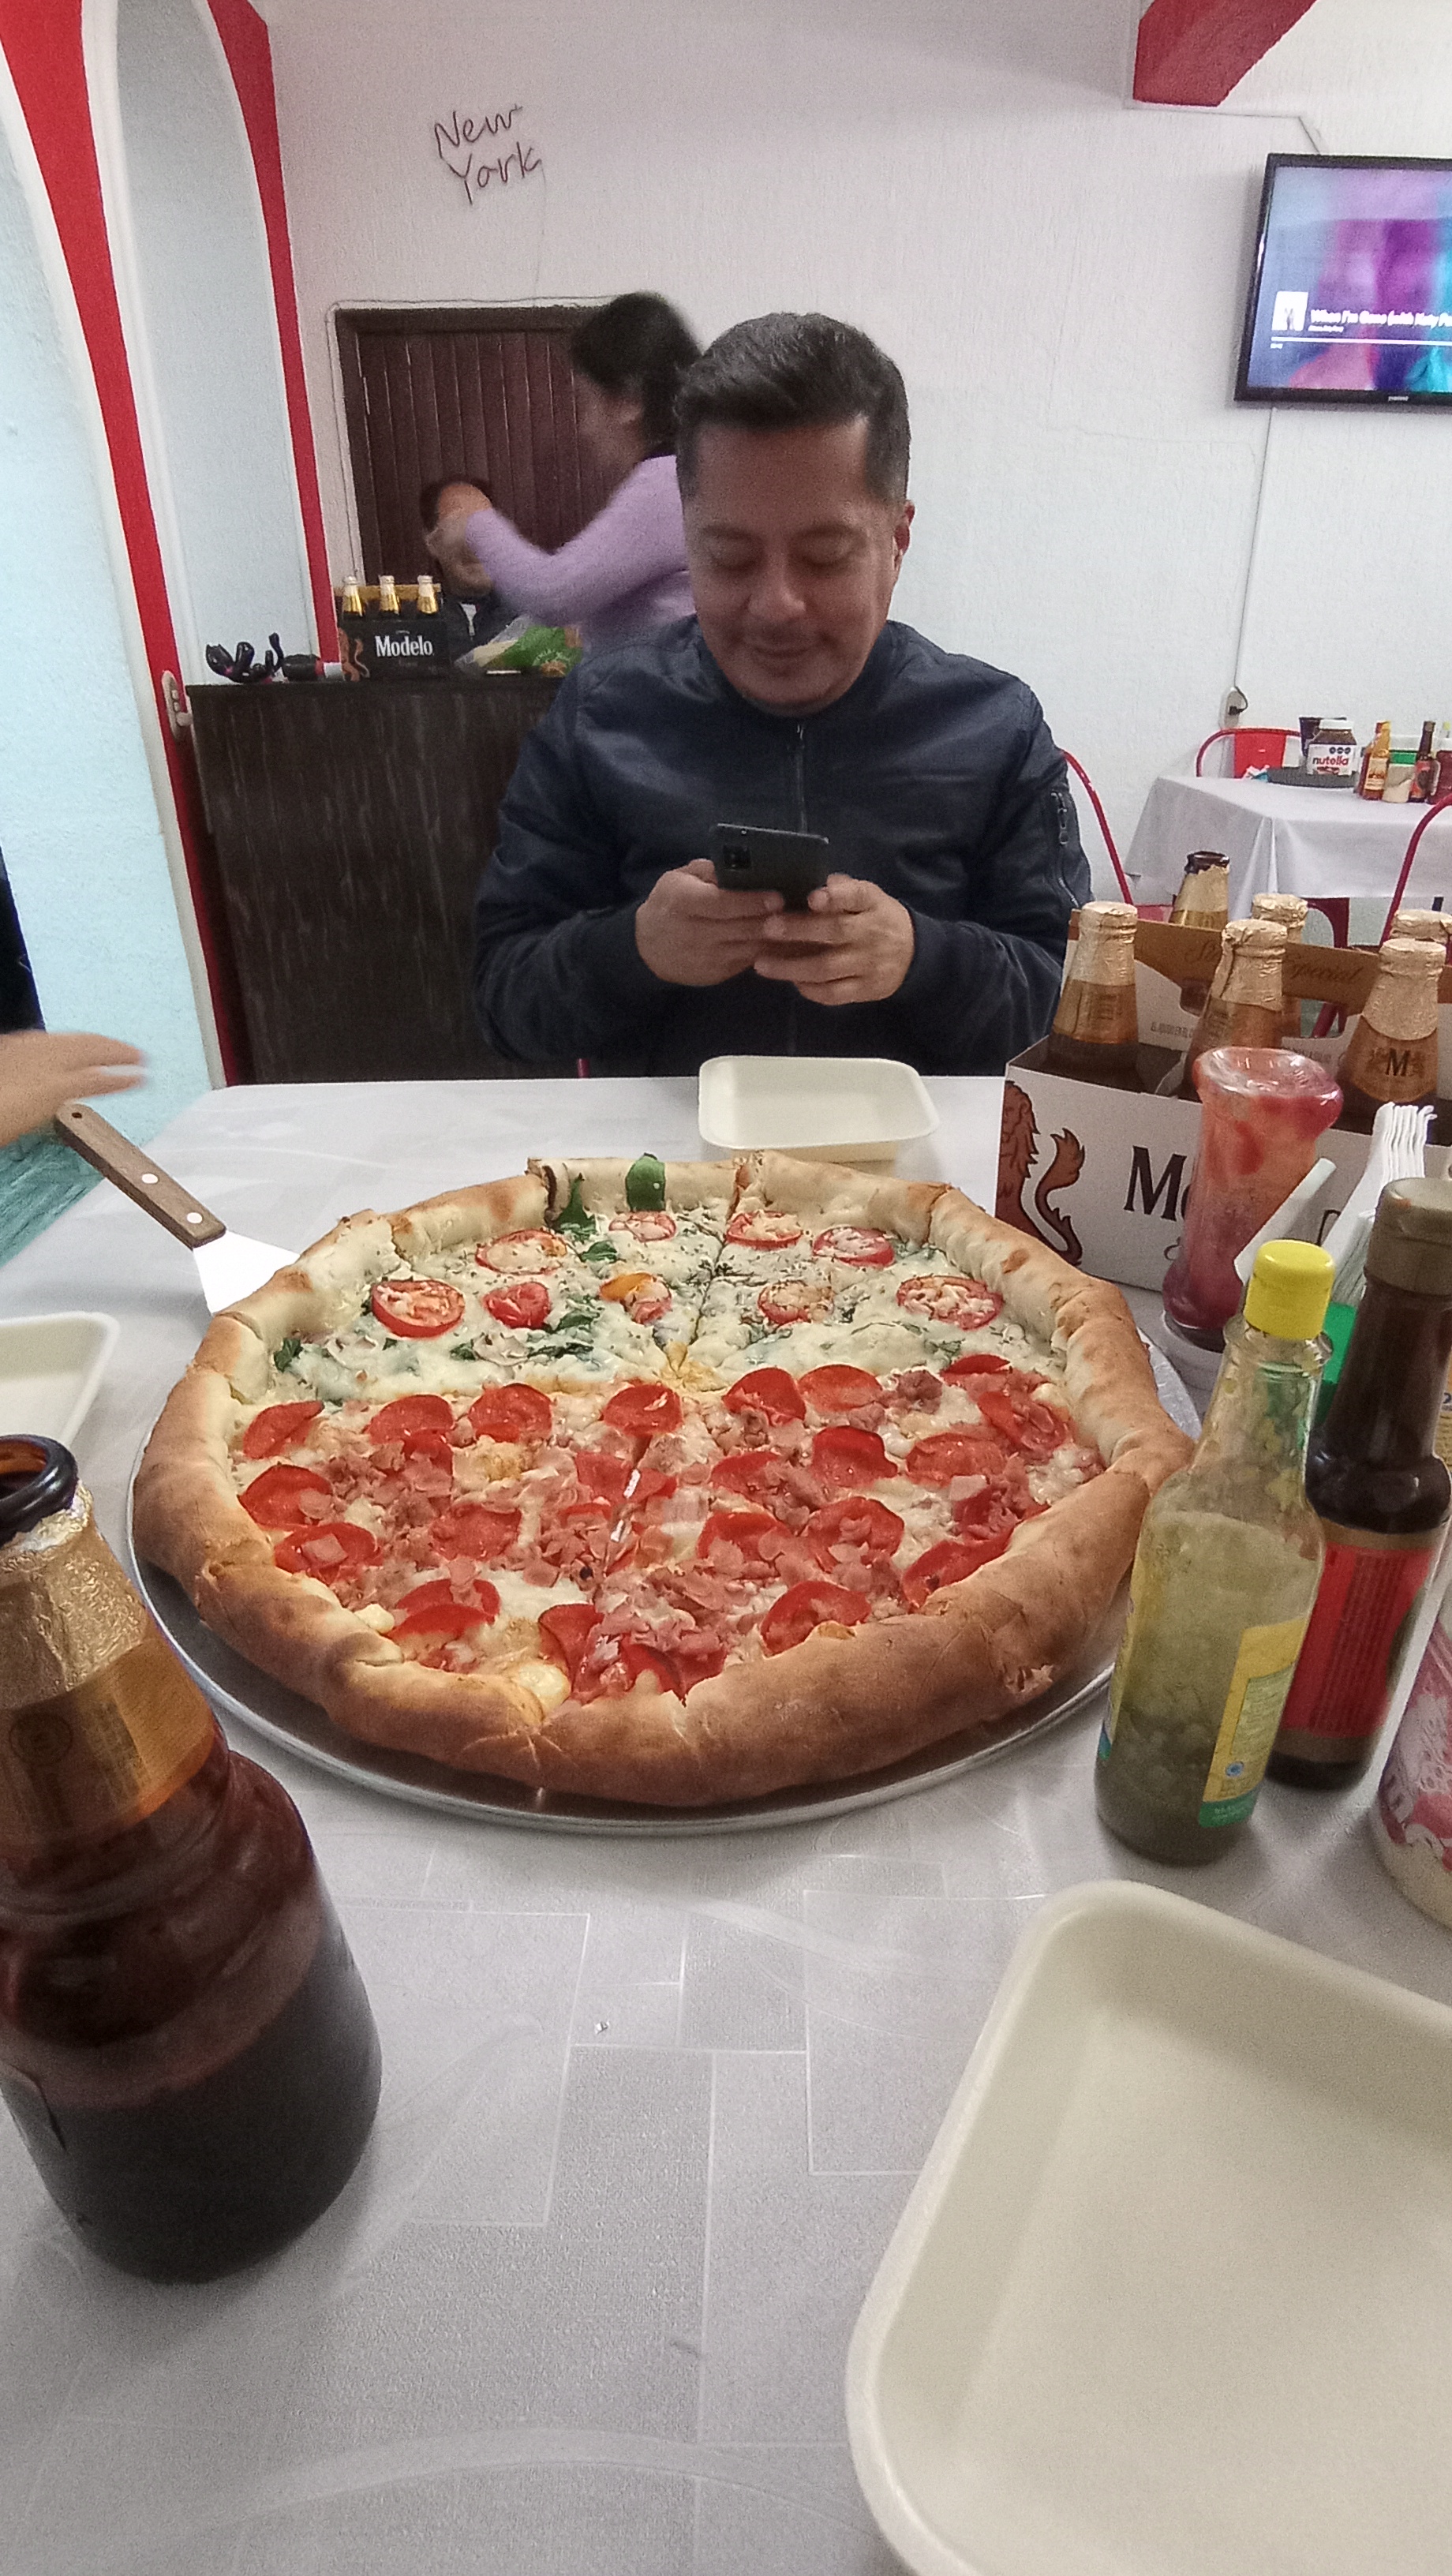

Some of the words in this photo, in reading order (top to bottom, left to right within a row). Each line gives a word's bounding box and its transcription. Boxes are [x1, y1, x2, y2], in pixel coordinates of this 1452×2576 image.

[434, 103, 523, 159] New
[447, 141, 544, 205] York
[374, 635, 434, 657] Modelo
[1312, 755, 1349, 766] nutella
